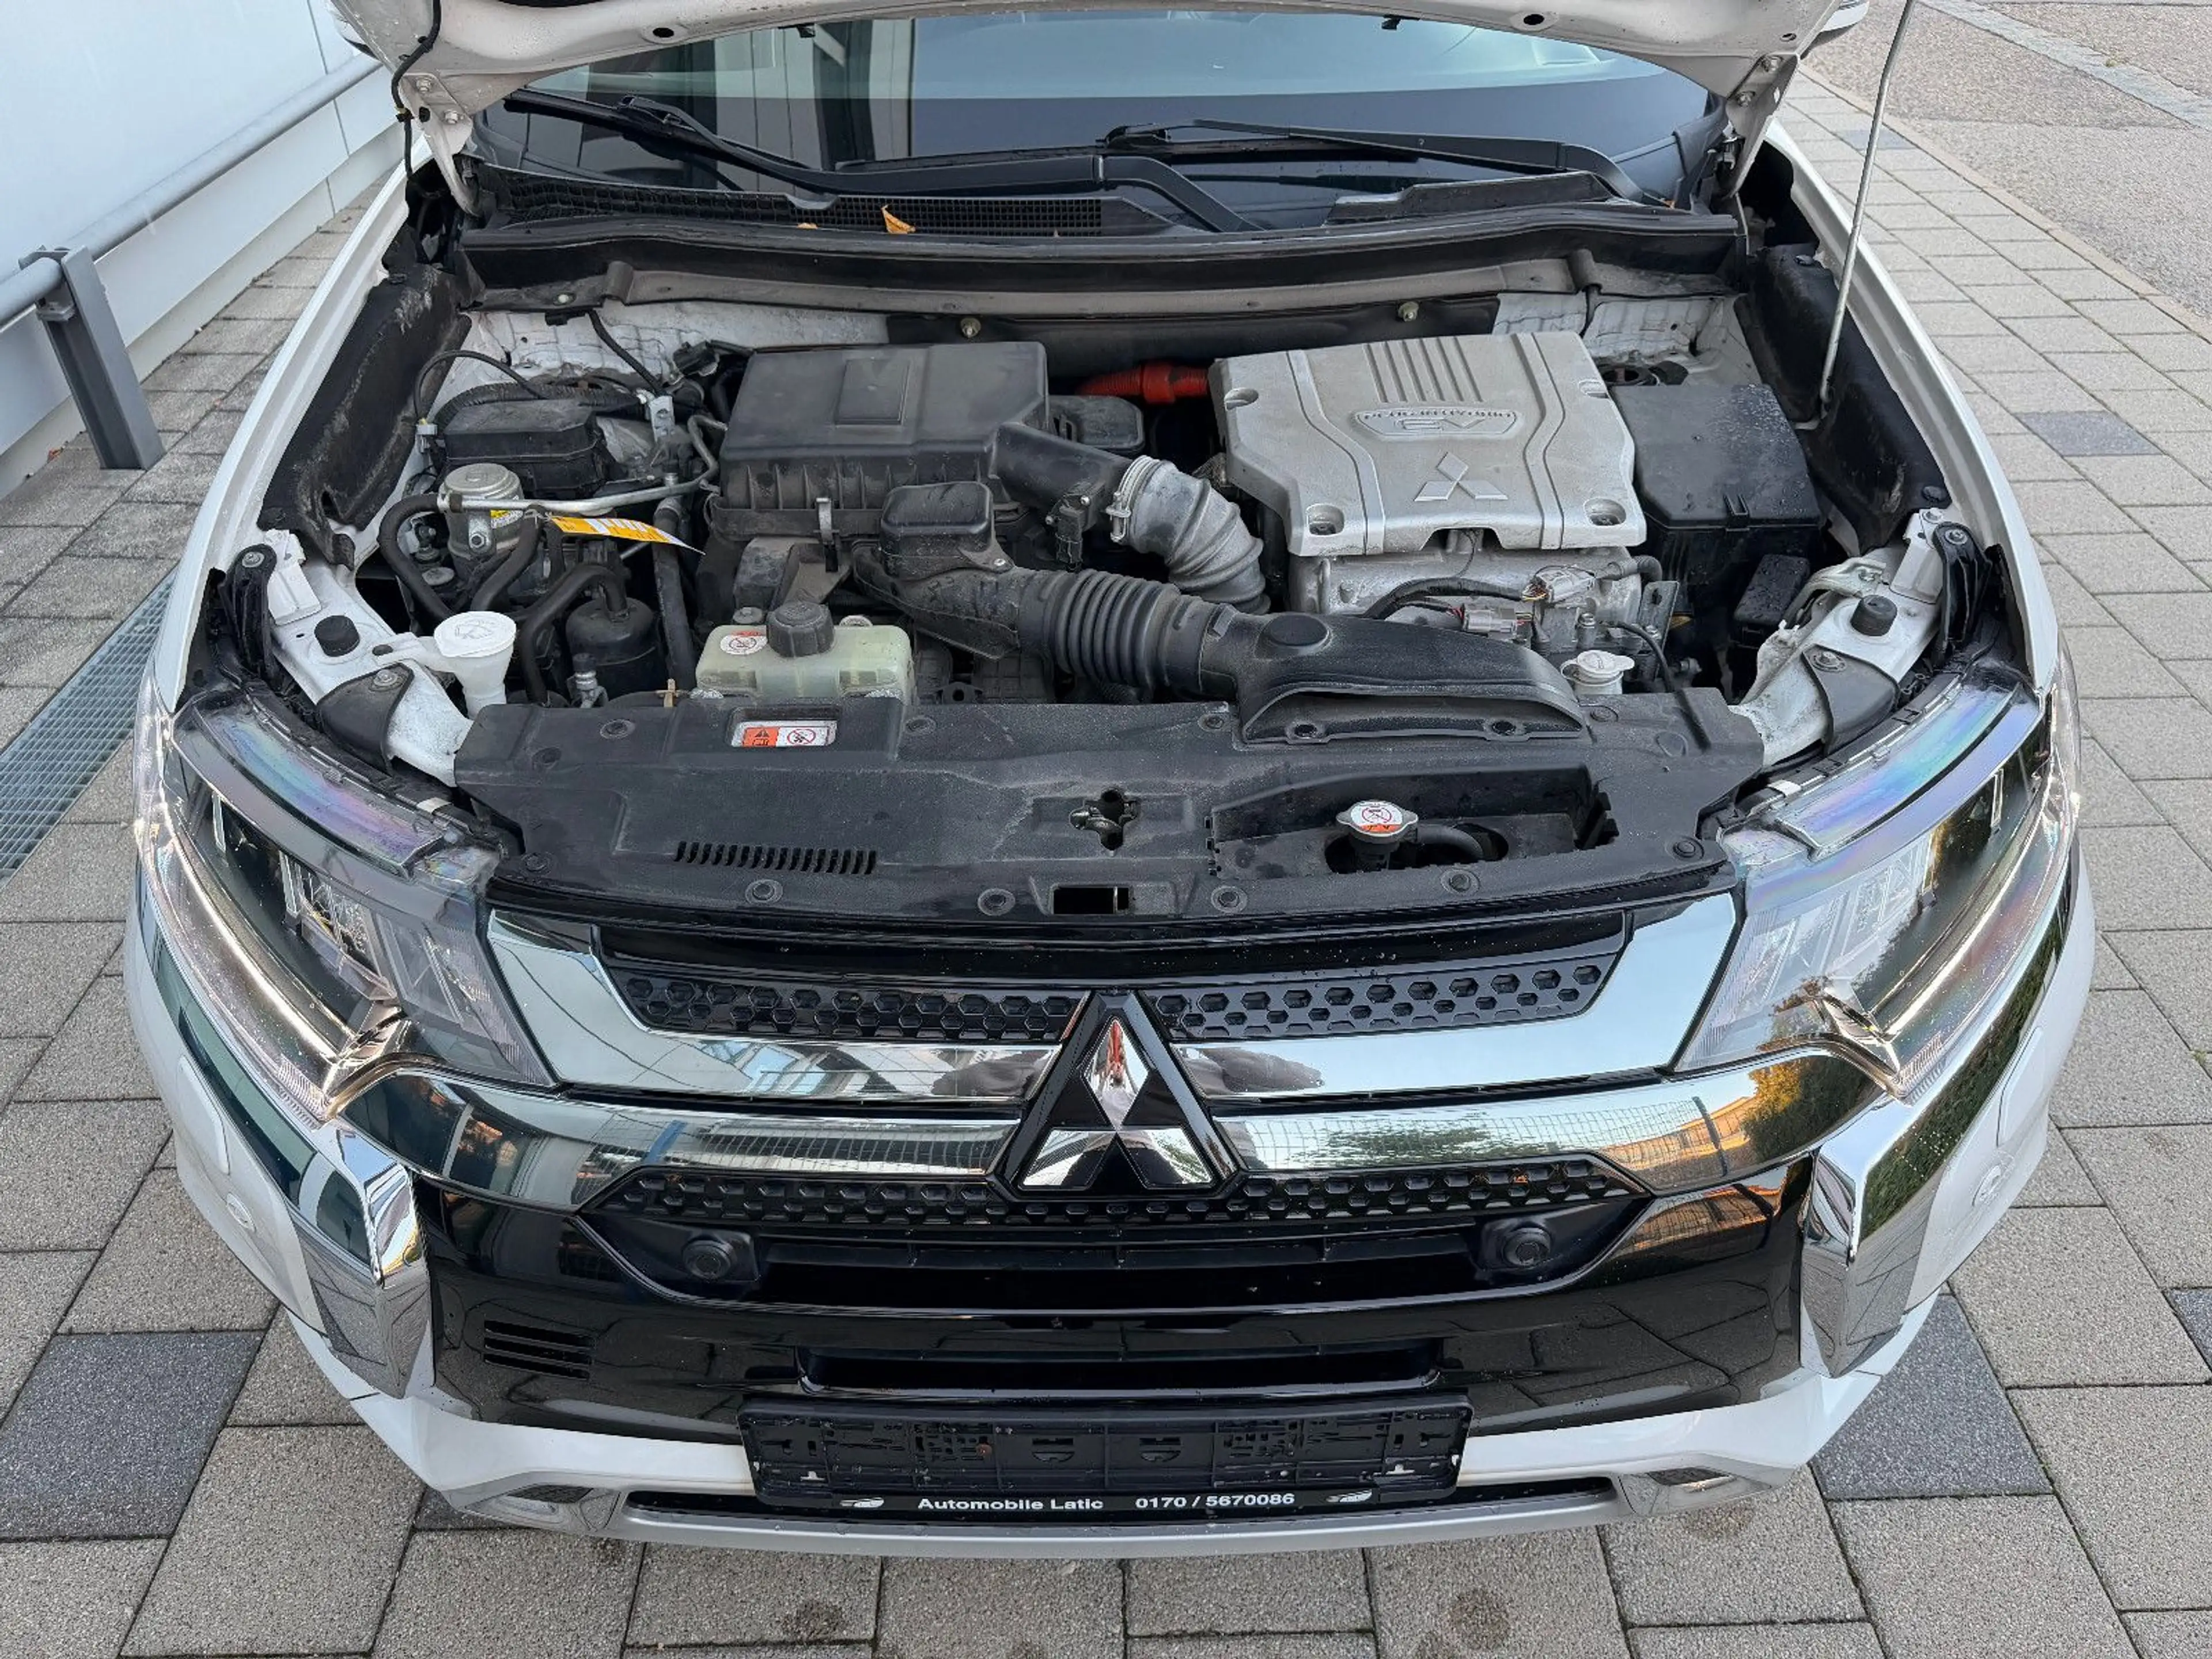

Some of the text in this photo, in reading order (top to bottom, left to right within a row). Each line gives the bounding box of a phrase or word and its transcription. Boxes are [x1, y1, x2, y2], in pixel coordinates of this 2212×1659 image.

[918, 1493, 1296, 1510] Automobile Latic 0170 / 5670086
